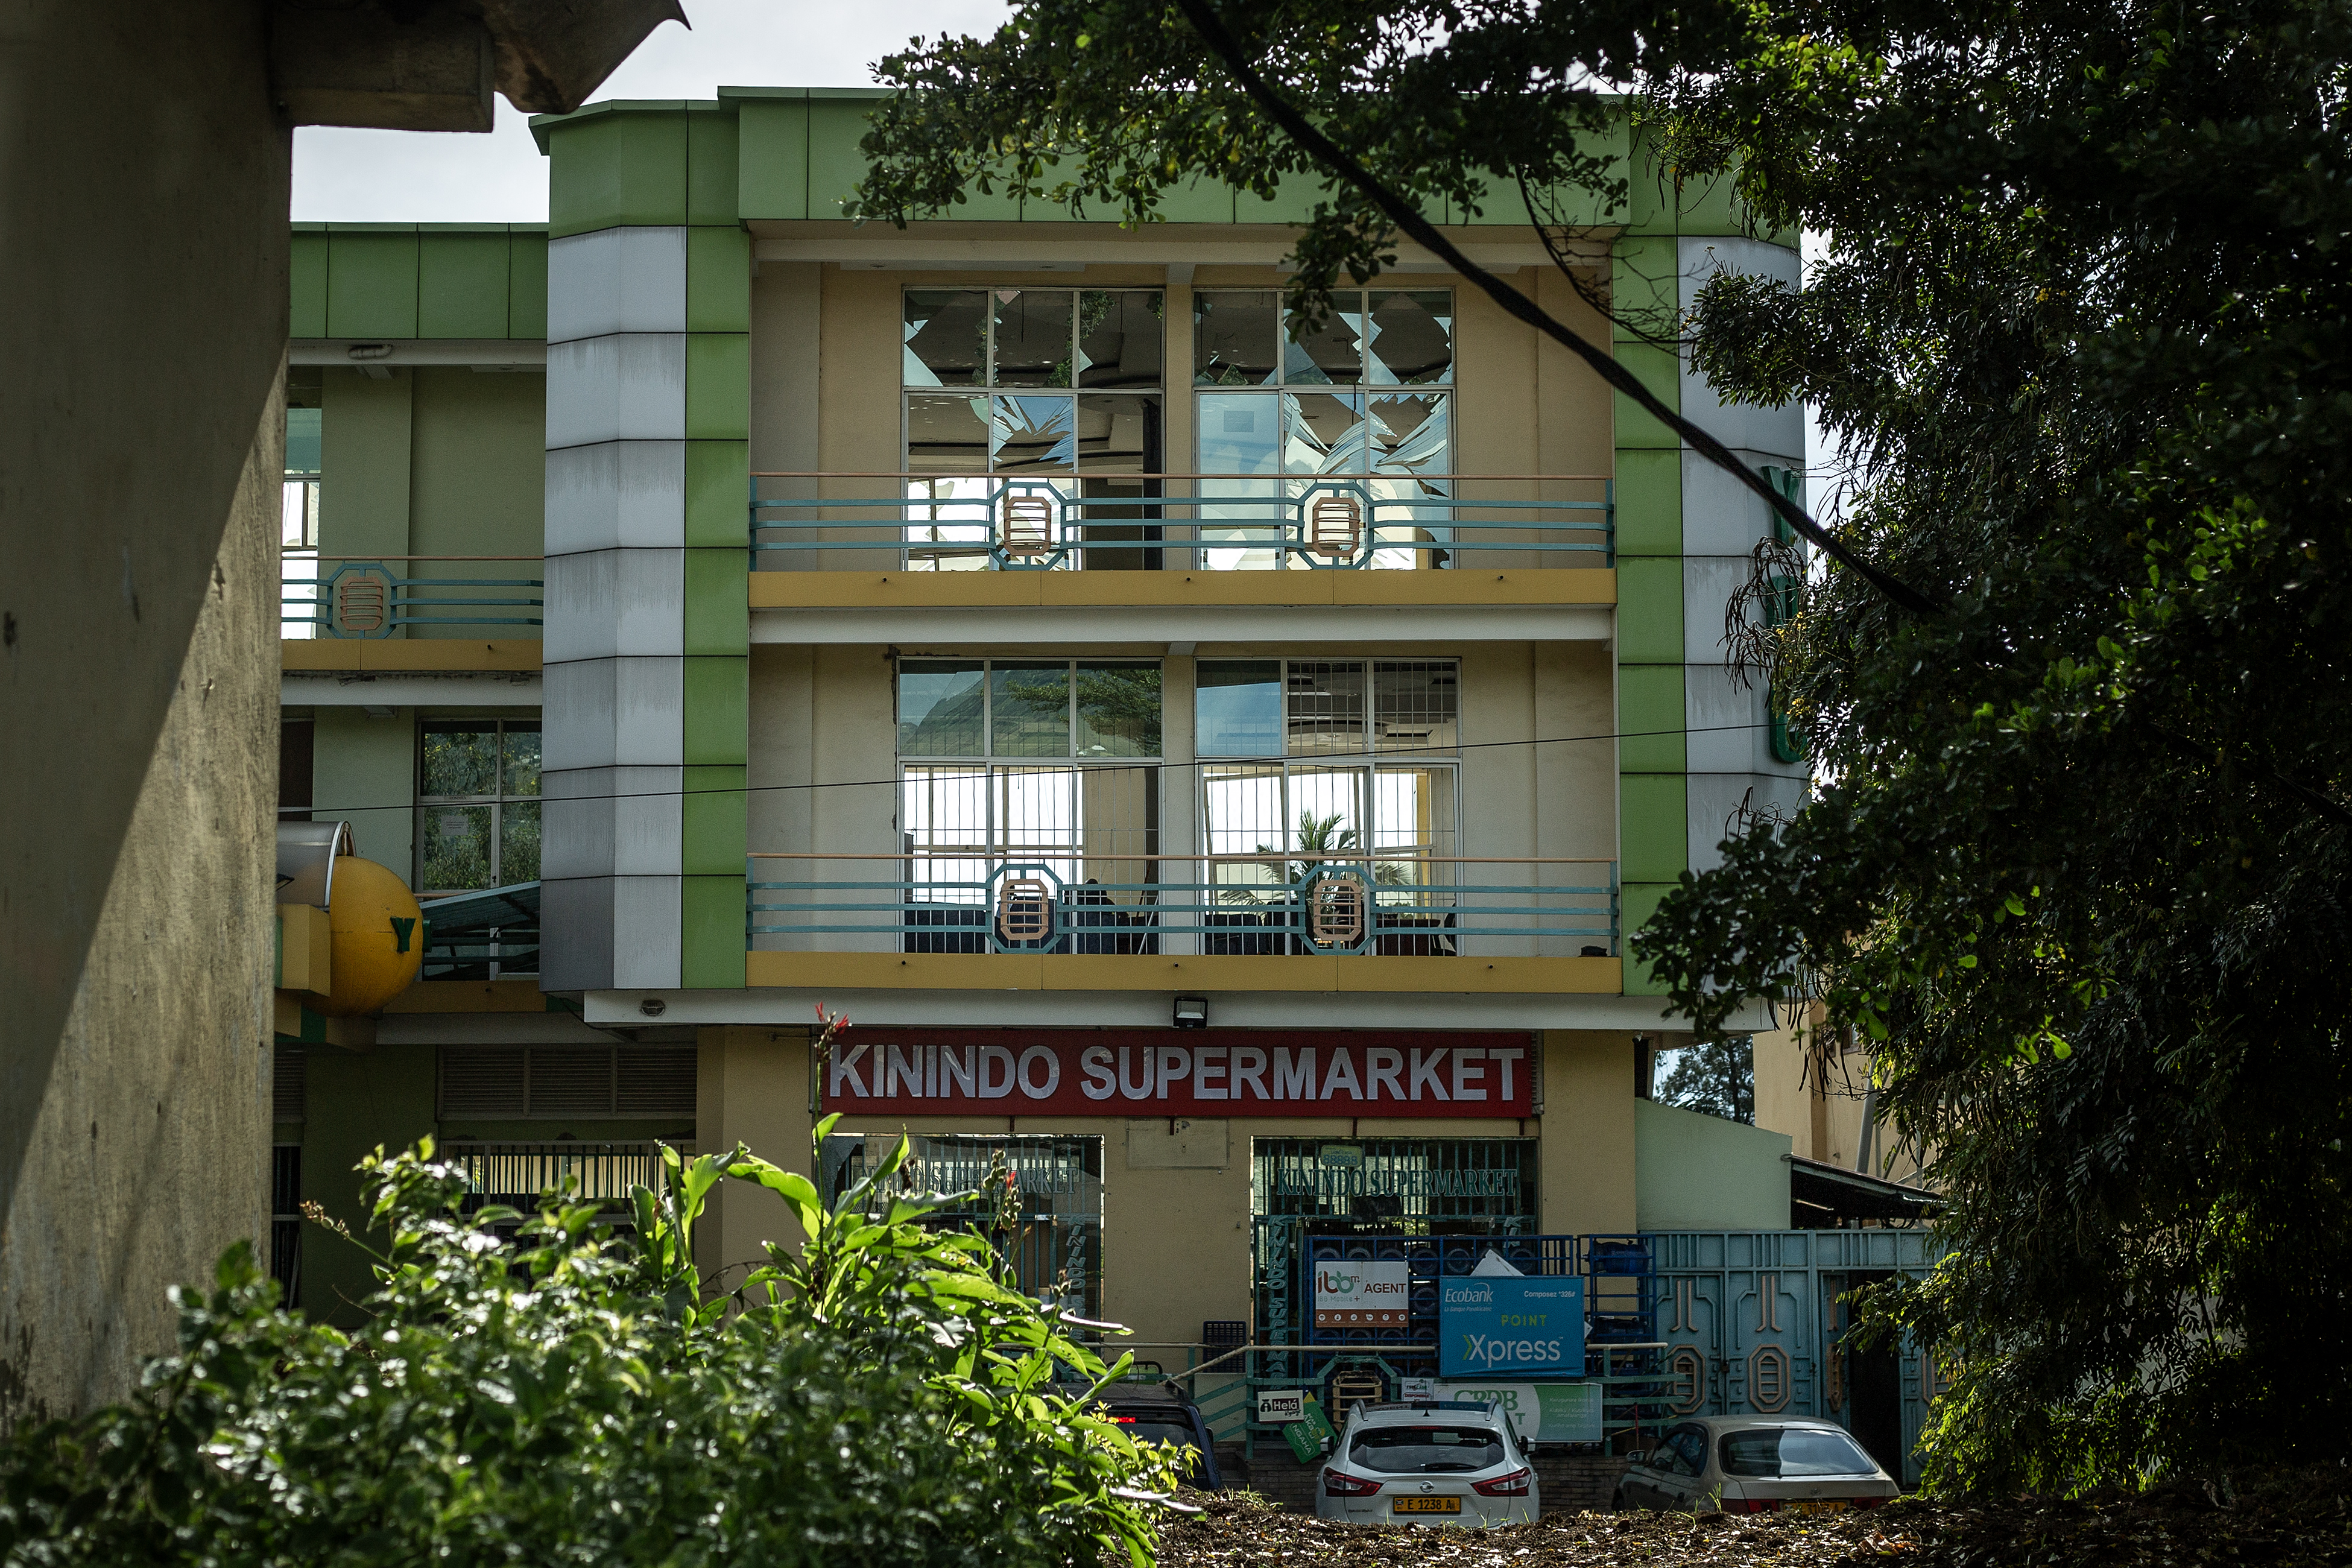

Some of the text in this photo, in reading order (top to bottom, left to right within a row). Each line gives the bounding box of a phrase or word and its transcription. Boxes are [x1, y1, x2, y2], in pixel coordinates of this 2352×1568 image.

[829, 1044, 1524, 1101] KININDO SUPERMARKET
[1277, 1168, 1518, 1197] KININDO SUPERMARKET
[1066, 1216, 1086, 1289] KININDO
[1266, 1216, 1287, 1289] KININDO
[1364, 1283, 1406, 1294] AGENT
[1445, 1283, 1493, 1303] Ecobank
[1501, 1315, 1547, 1327] POINT
[1469, 1334, 1561, 1368] Xpress
[1273, 1399, 1297, 1410] Helá
[1291, 1424, 1313, 1454] NGAHA
[1408, 1499, 1414, 1510] E
[1418, 1499, 1442, 1510] 1238
